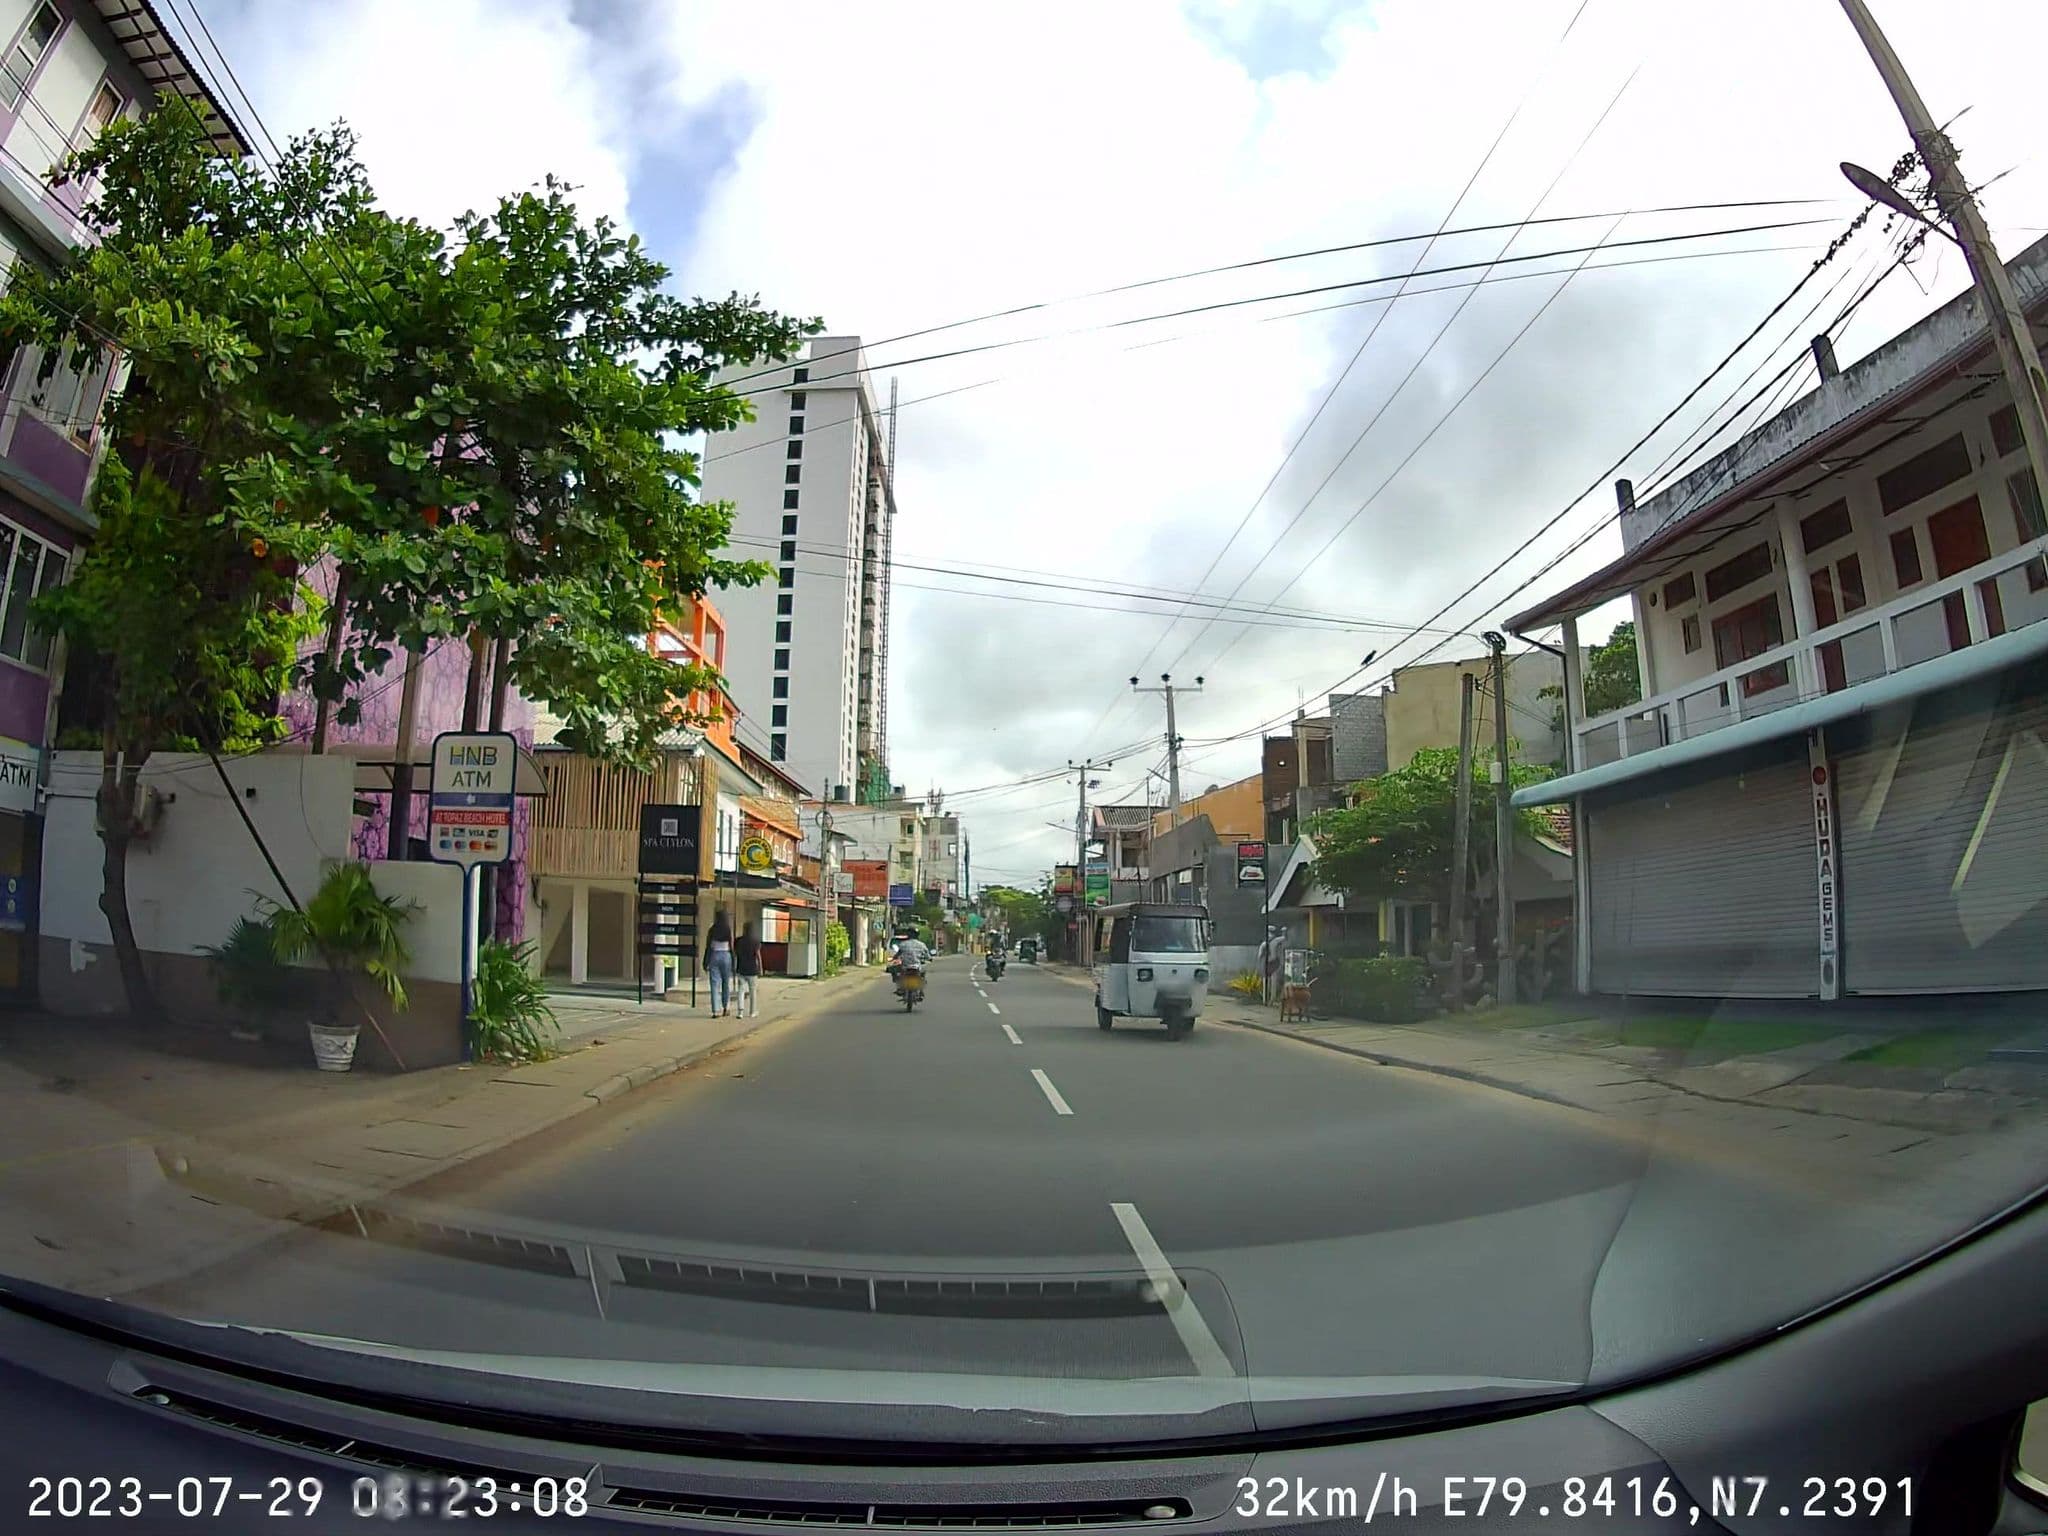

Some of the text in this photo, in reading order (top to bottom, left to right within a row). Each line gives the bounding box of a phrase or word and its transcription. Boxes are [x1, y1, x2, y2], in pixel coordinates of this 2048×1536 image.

[450, 746, 498, 766] HNB
[0, 762, 31, 789] ATM
[452, 770, 492, 788] ATM
[487, 814, 506, 824] HOTEL
[469, 829, 486, 837] VISA
[1822, 882, 1834, 941] GEMS
